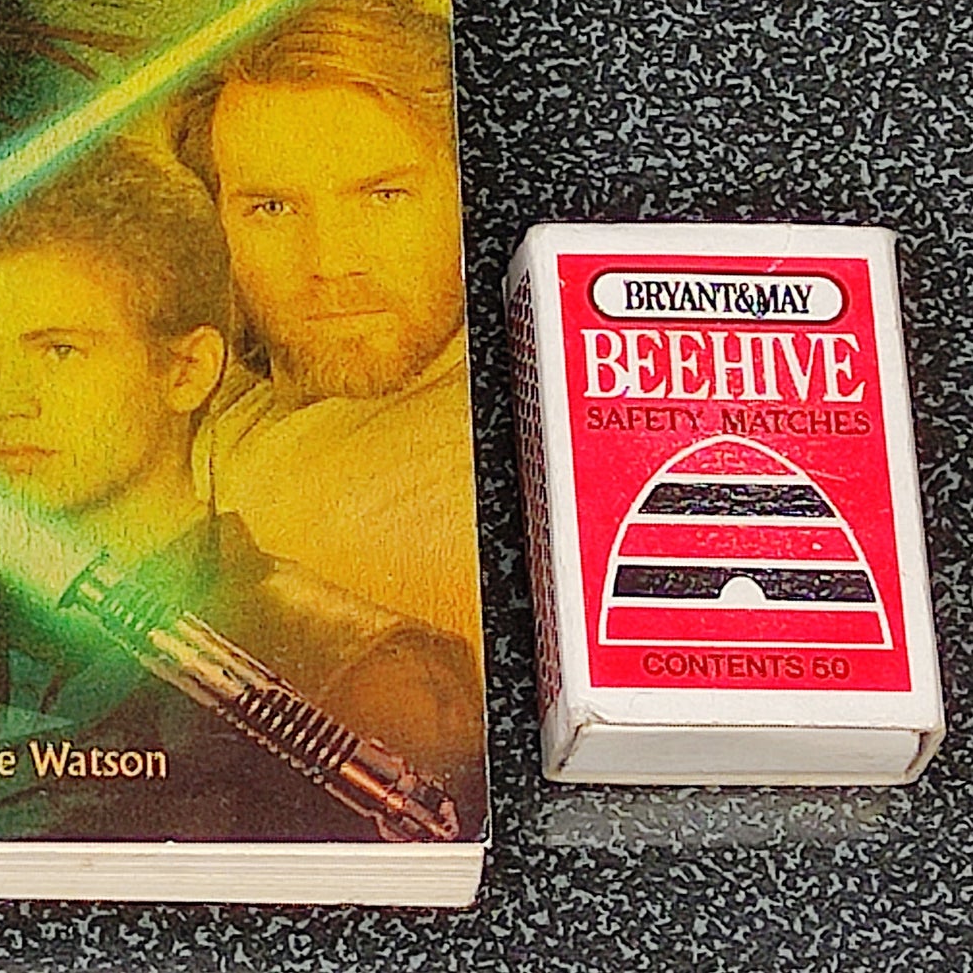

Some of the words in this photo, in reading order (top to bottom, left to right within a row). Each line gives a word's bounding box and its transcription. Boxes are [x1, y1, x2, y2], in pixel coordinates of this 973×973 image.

[580, 328, 866, 403] BEEHIVE
[587, 406, 703, 431] SAFETY
[721, 409, 871, 435] MATCHES
[642, 652, 804, 678] CONTENTS
[812, 656, 850, 679] 50
[29, 739, 167, 779] Watson
